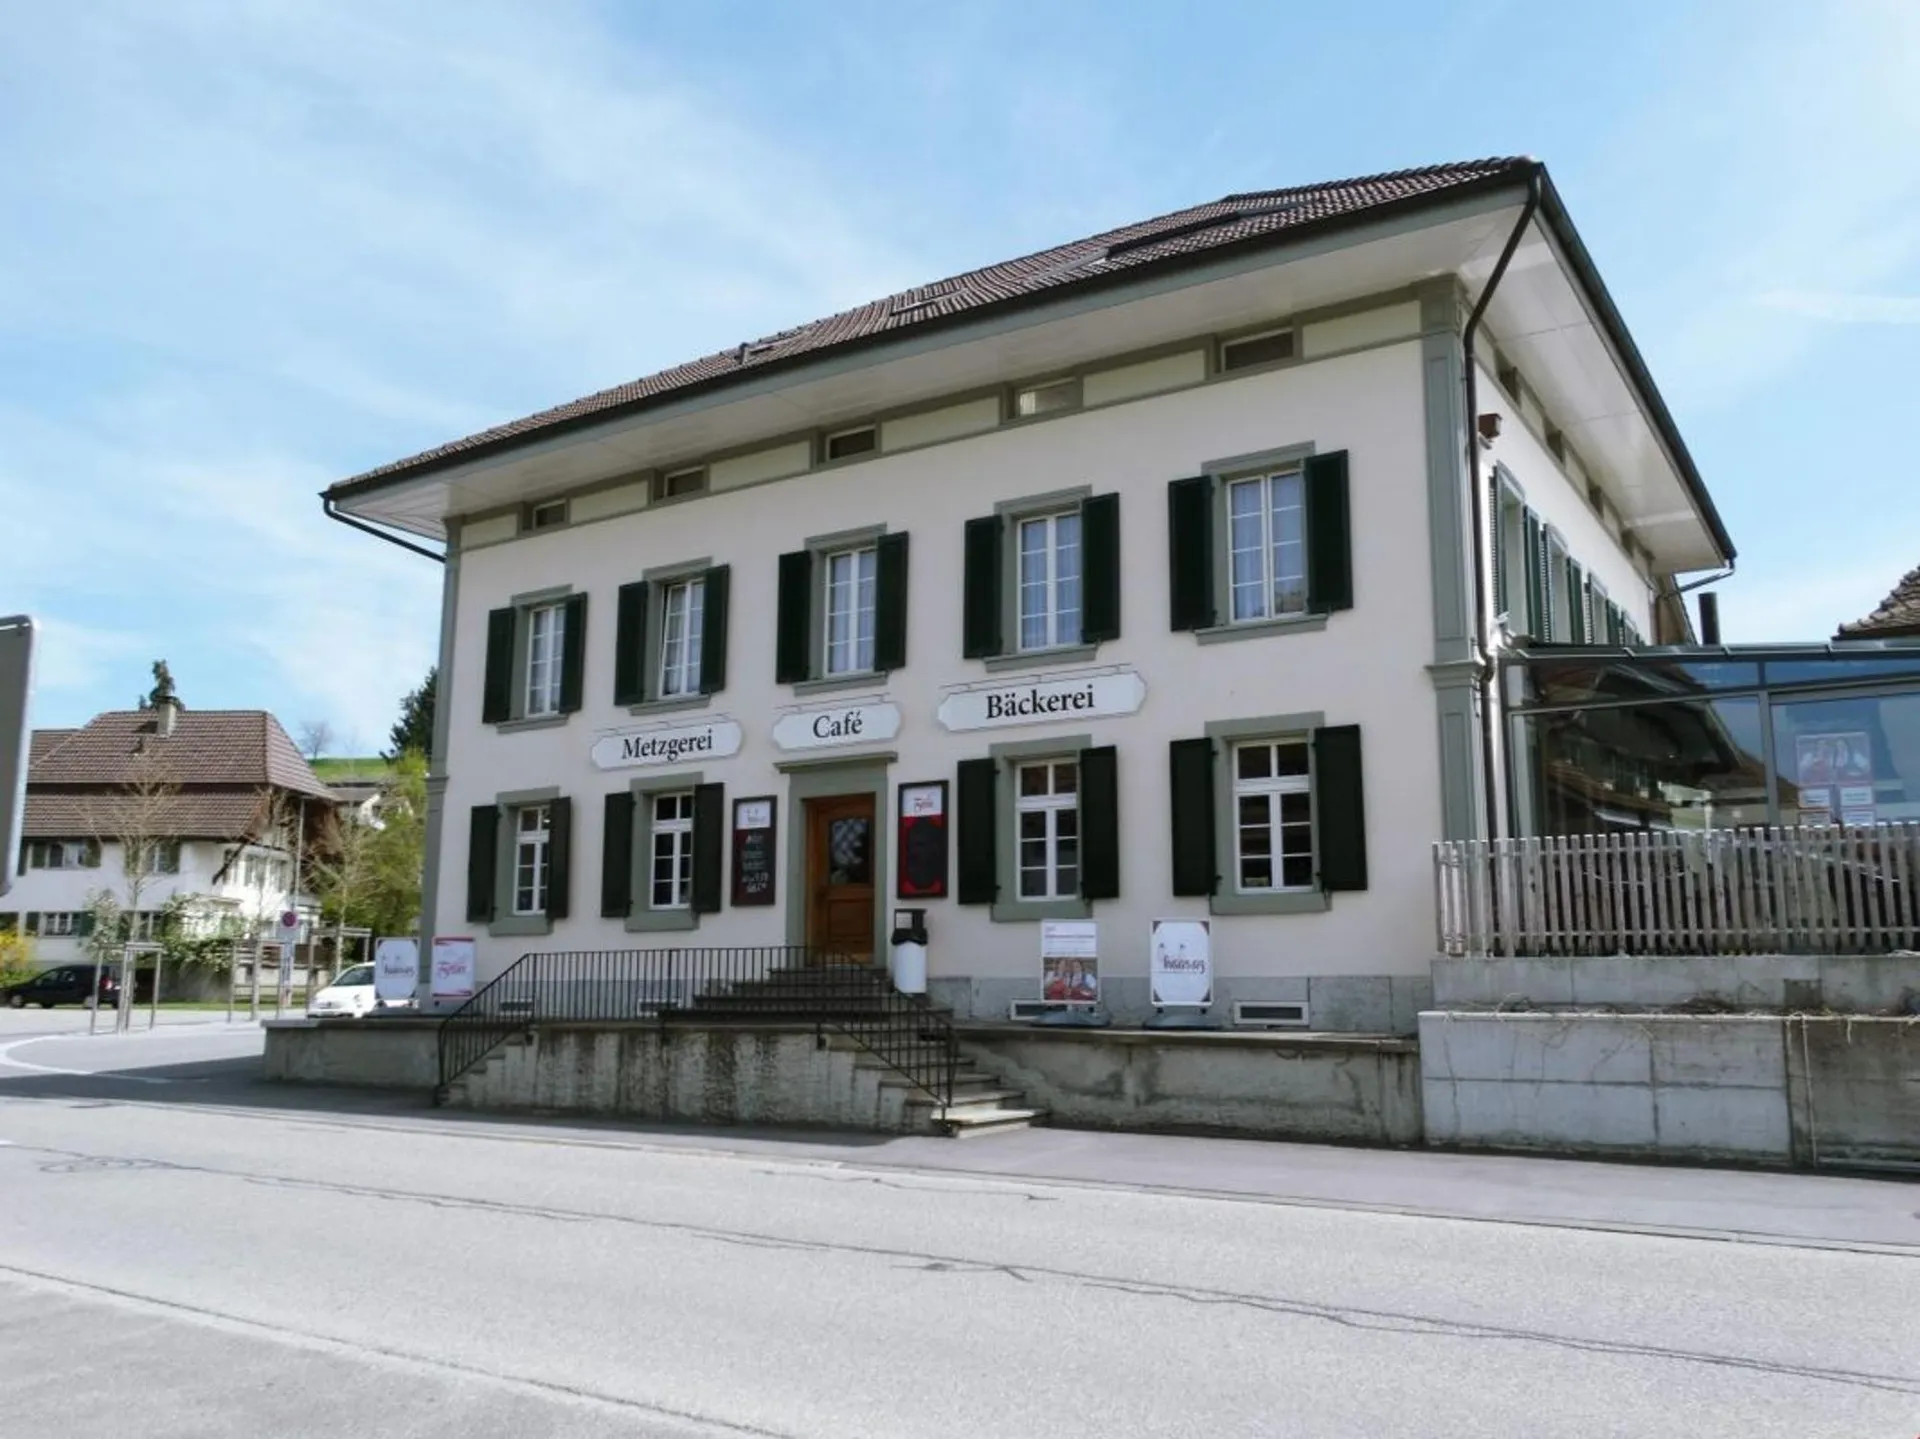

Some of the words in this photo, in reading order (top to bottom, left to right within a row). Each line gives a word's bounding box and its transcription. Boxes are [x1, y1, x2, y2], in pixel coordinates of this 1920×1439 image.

[986, 684, 1095, 719] Bäckerei
[813, 710, 863, 739] Café
[621, 728, 713, 761] Metzgerei
